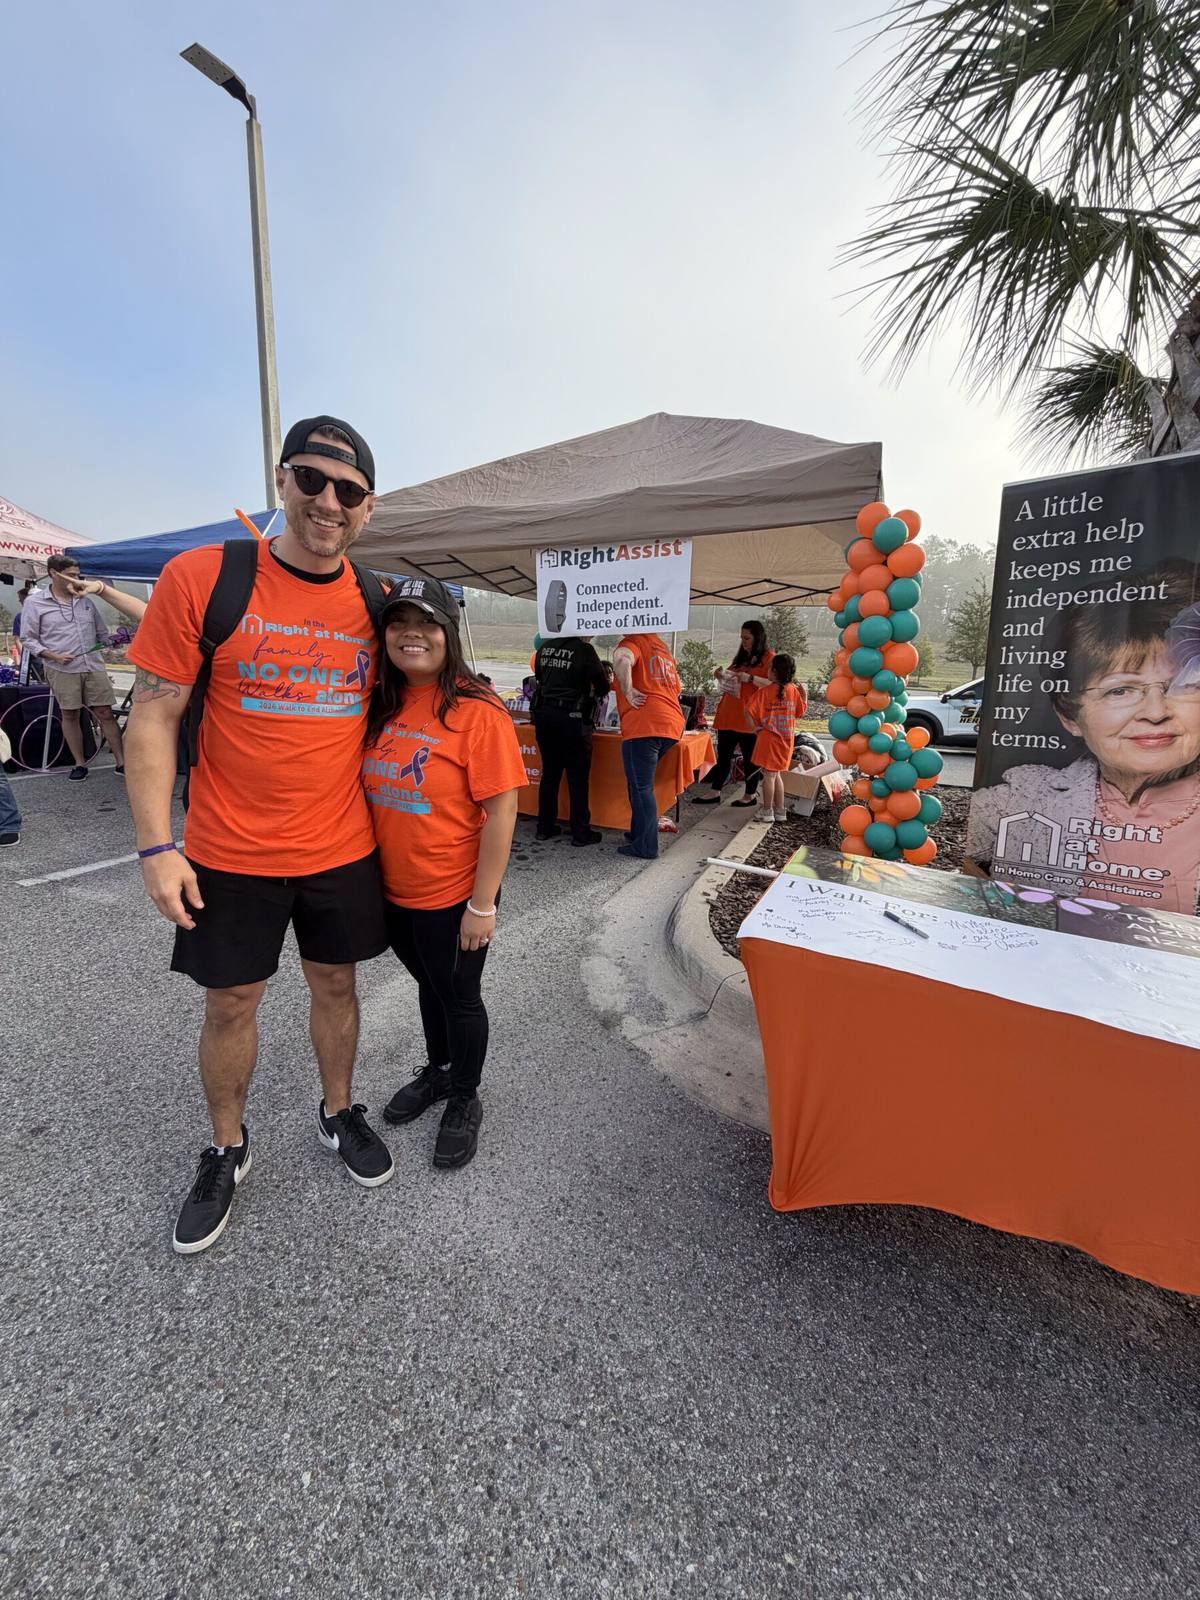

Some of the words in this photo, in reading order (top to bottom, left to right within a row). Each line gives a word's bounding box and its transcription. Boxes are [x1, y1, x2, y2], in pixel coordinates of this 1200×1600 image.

[1015, 500, 1035, 522] A
[1041, 492, 1104, 518] little
[1012, 531, 1075, 552] extra
[1085, 518, 1144, 544] help
[560, 539, 682, 570] RightAssist
[1008, 558, 1081, 581] keeps
[1089, 555, 1132, 574] me
[576, 578, 649, 596] Connected.
[1005, 580, 1169, 611] independent
[576, 596, 664, 614] Independent.
[265, 622, 309, 636] Right
[314, 630, 330, 639] at
[576, 617, 612, 630] Peace
[614, 614, 630, 628] of
[632, 612, 672, 627] Mind.
[1002, 617, 1045, 638] and
[253, 635, 335, 668] family,
[542, 648, 574, 659] DEPUTY
[1000, 646, 1067, 669] living
[237, 661, 280, 680] NO
[288, 663, 344, 686] ONE
[997, 674, 1032, 693] life
[1040, 678, 1069, 693] on
[239, 679, 311, 701] Walks
[994, 705, 1030, 724] my
[992, 730, 1067, 750] terms.
[363, 757, 399, 780] ONE
[379, 782, 429, 803] alone.
[1068, 817, 1162, 843] Right
[1065, 837, 1099, 854] at
[1063, 853, 1165, 881] Home
[994, 864, 1005, 874] In
[1008, 866, 1041, 879] Home
[1044, 872, 1073, 885] Care
[1075, 878, 1085, 887] &
[1088, 880, 1162, 899] Assistance
[808, 884, 873, 906] Walk
